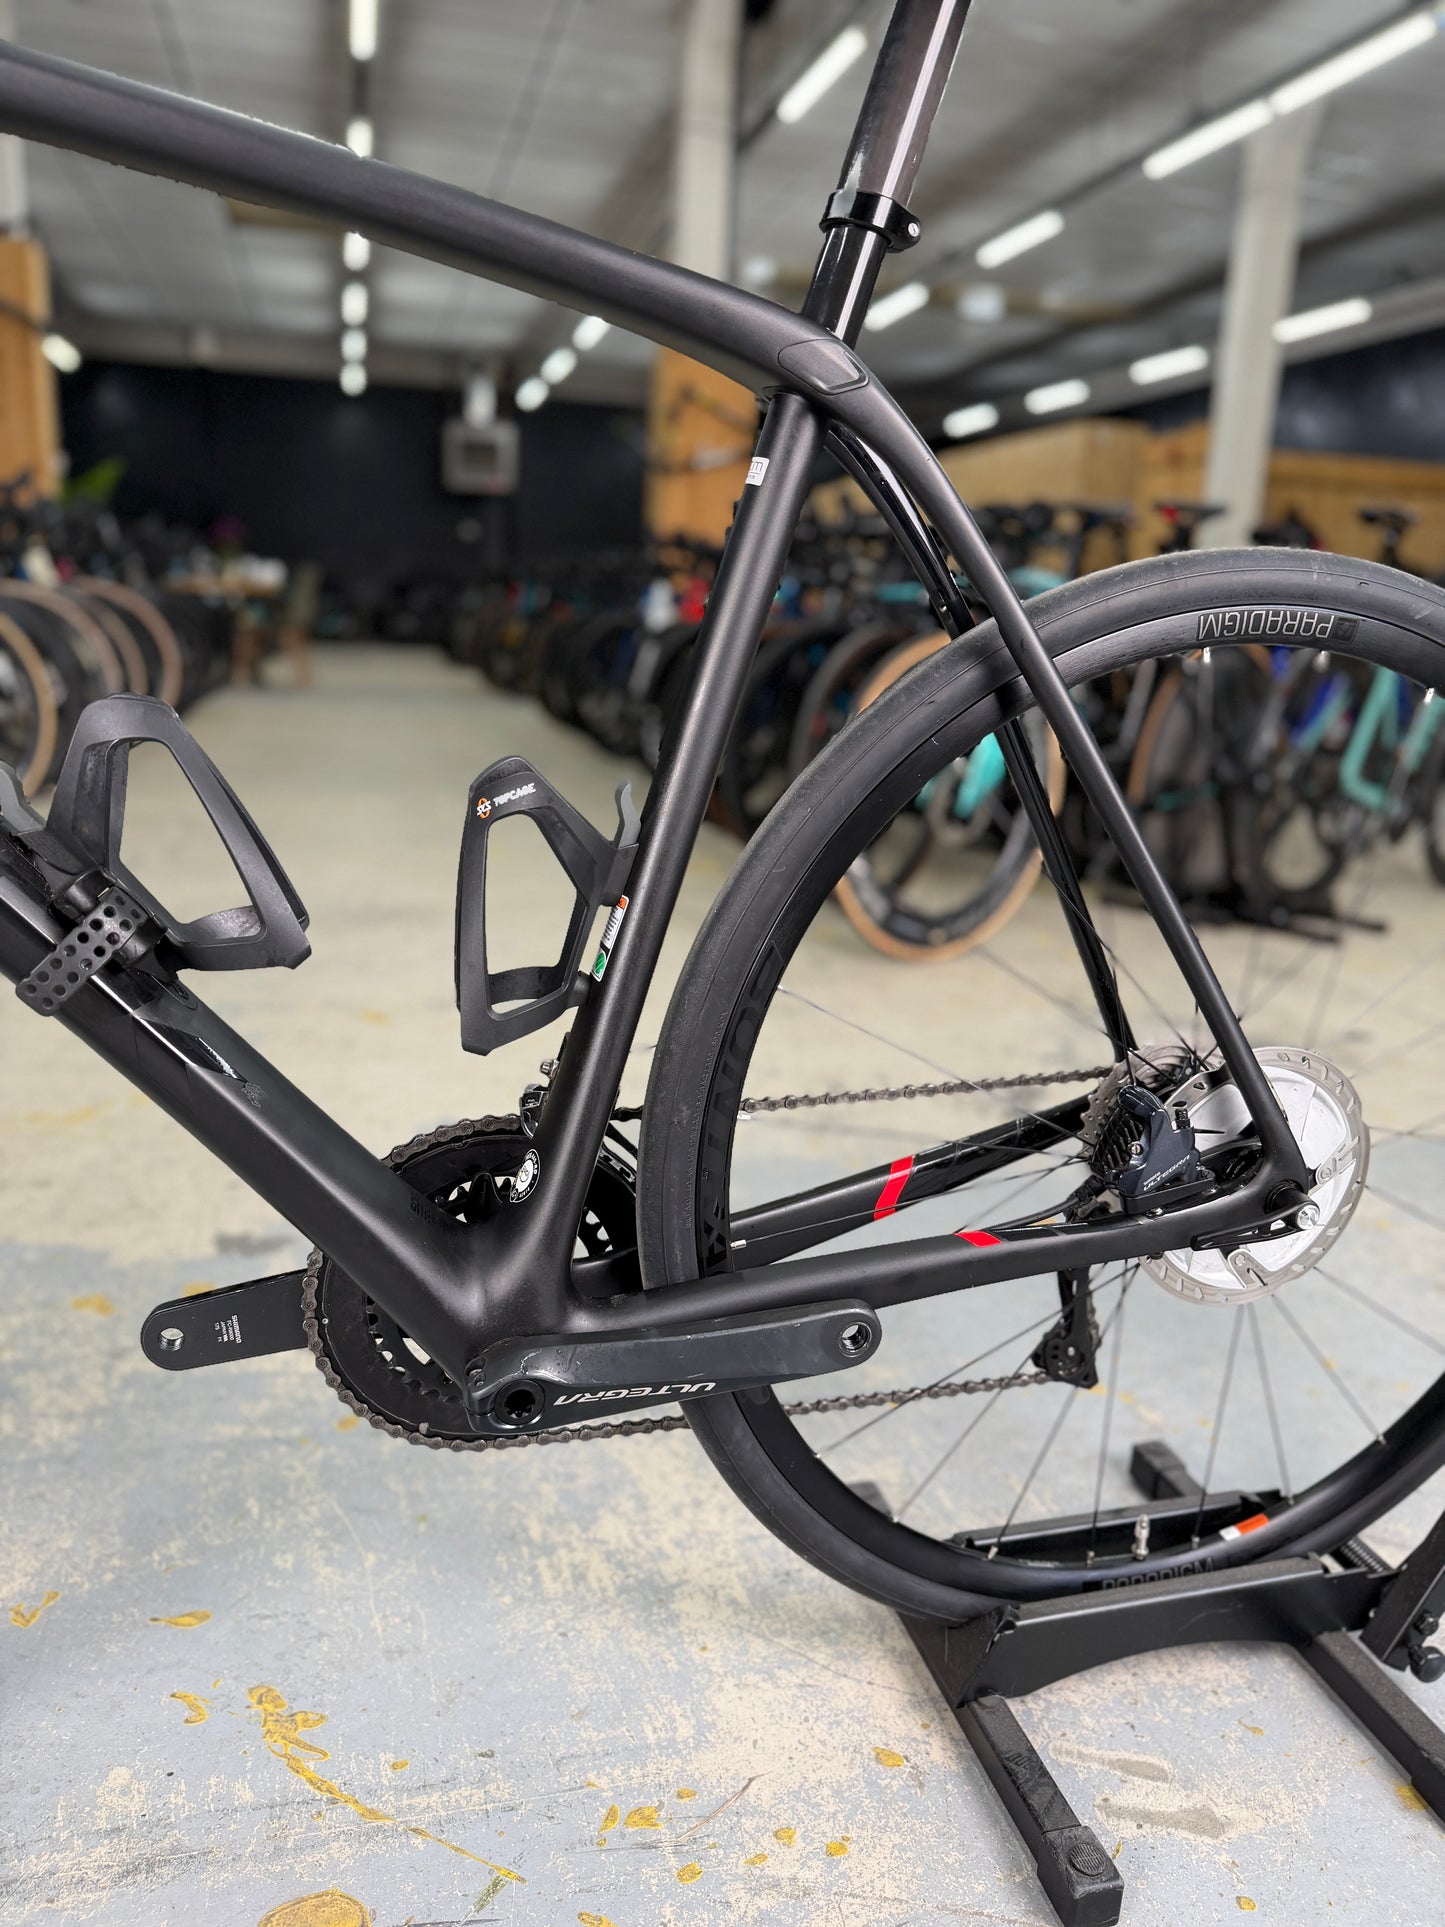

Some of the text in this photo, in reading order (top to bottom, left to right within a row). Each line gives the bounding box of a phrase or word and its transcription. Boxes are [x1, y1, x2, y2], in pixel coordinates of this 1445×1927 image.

[1199, 610, 1334, 640] PARADIGM
[493, 783, 537, 807] TOPCAGE
[1143, 1154, 1190, 1192] ULTEGRA
[231, 1314, 242, 1344] SHIMANO
[552, 1382, 717, 1406] ULTEGRA
